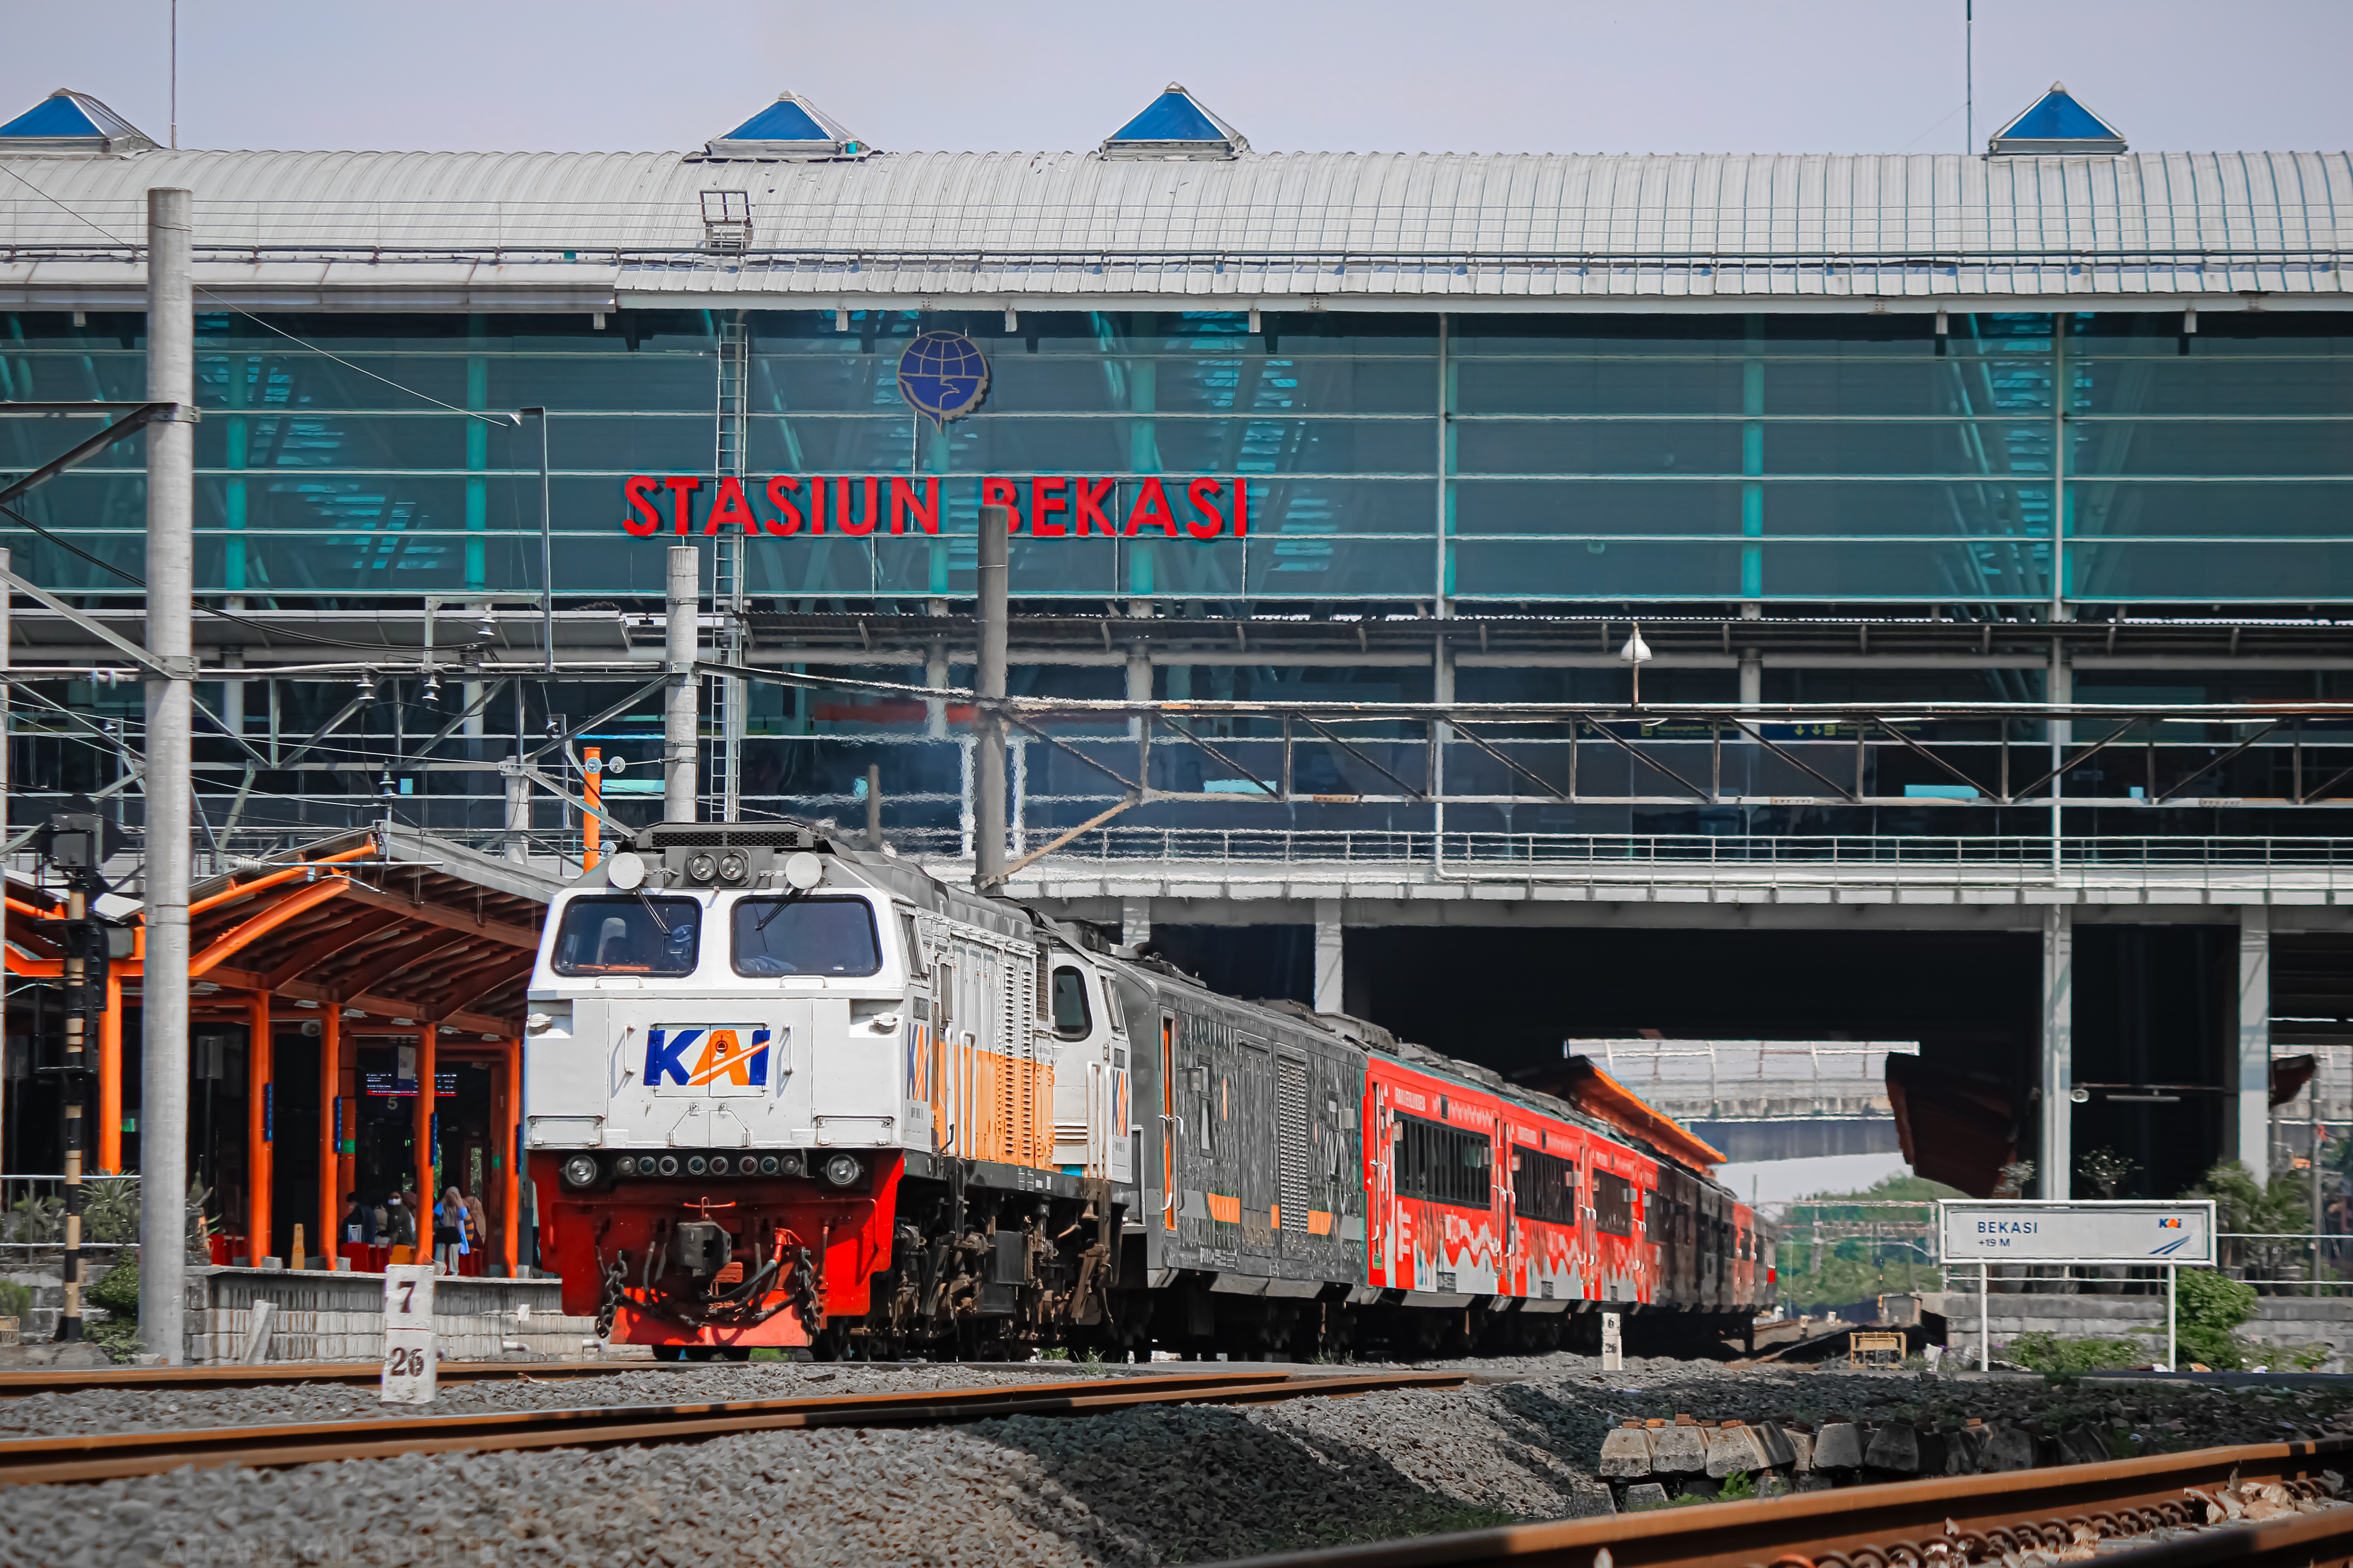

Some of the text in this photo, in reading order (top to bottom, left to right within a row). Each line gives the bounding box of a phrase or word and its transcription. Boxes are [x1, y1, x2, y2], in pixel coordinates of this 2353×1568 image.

[622, 475, 1246, 538] STASIUN BEKASI
[644, 1029, 771, 1087] KAI
[387, 1097, 398, 1110] 5
[1978, 1221, 2037, 1234] BEKASI
[1979, 1238, 2010, 1247] +19 M
[398, 1281, 417, 1313] 7
[390, 1347, 425, 1377] 26
